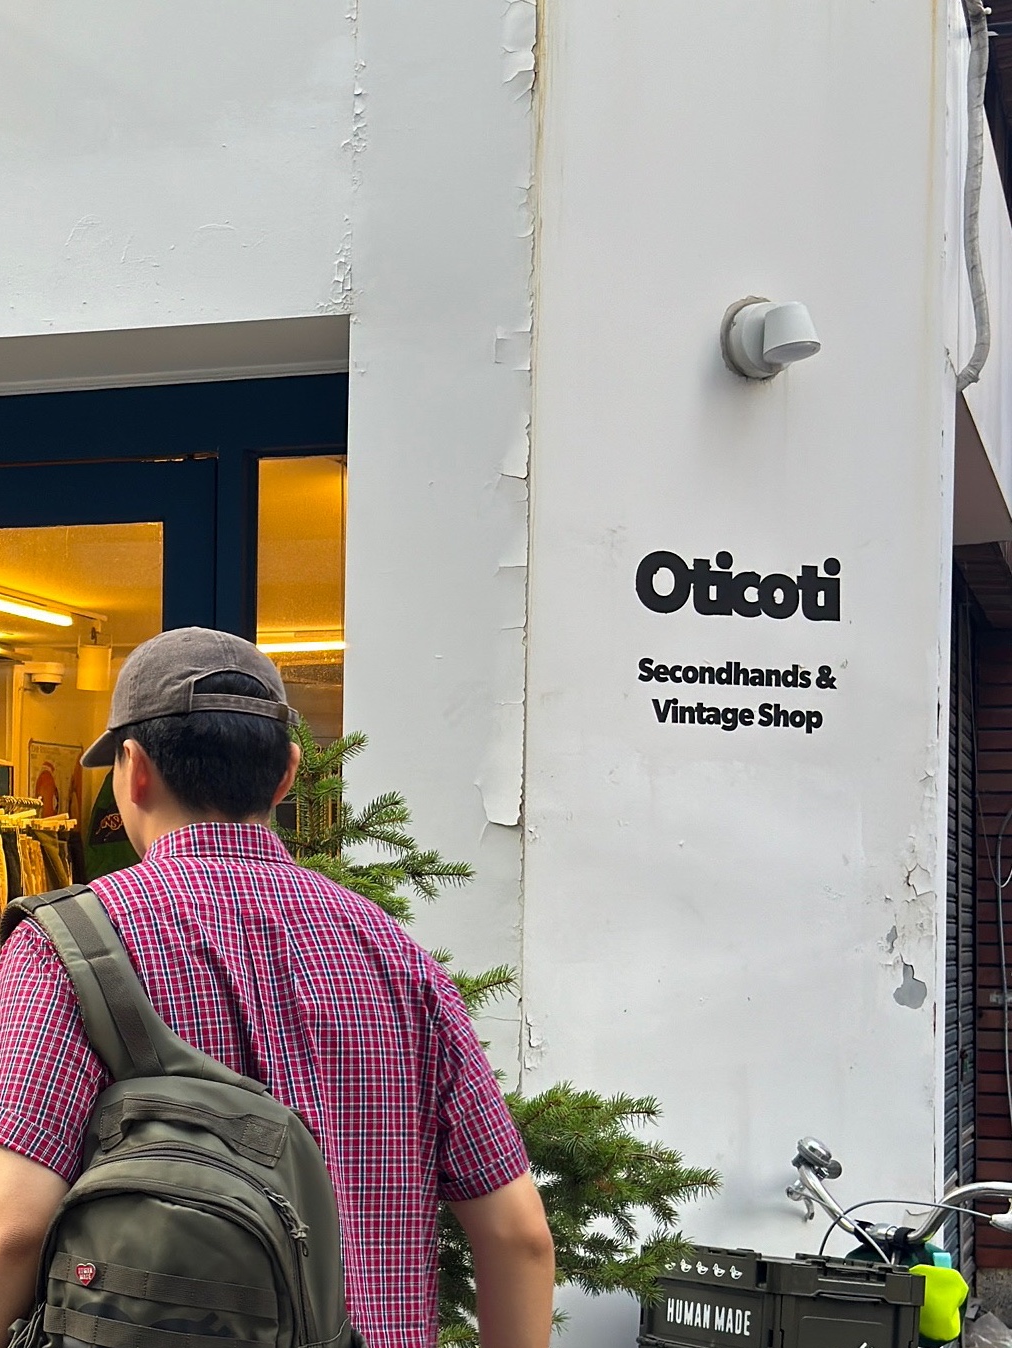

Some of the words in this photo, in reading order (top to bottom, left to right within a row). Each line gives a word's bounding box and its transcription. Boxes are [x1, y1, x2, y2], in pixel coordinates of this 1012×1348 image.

[636, 550, 841, 622] Oticoti
[638, 657, 812, 689] Secondhands
[815, 665, 838, 690] &
[651, 697, 755, 732] Vintage
[758, 703, 824, 734] Shop
[666, 1298, 711, 1330] HUMAN
[714, 1306, 752, 1337] MADE
